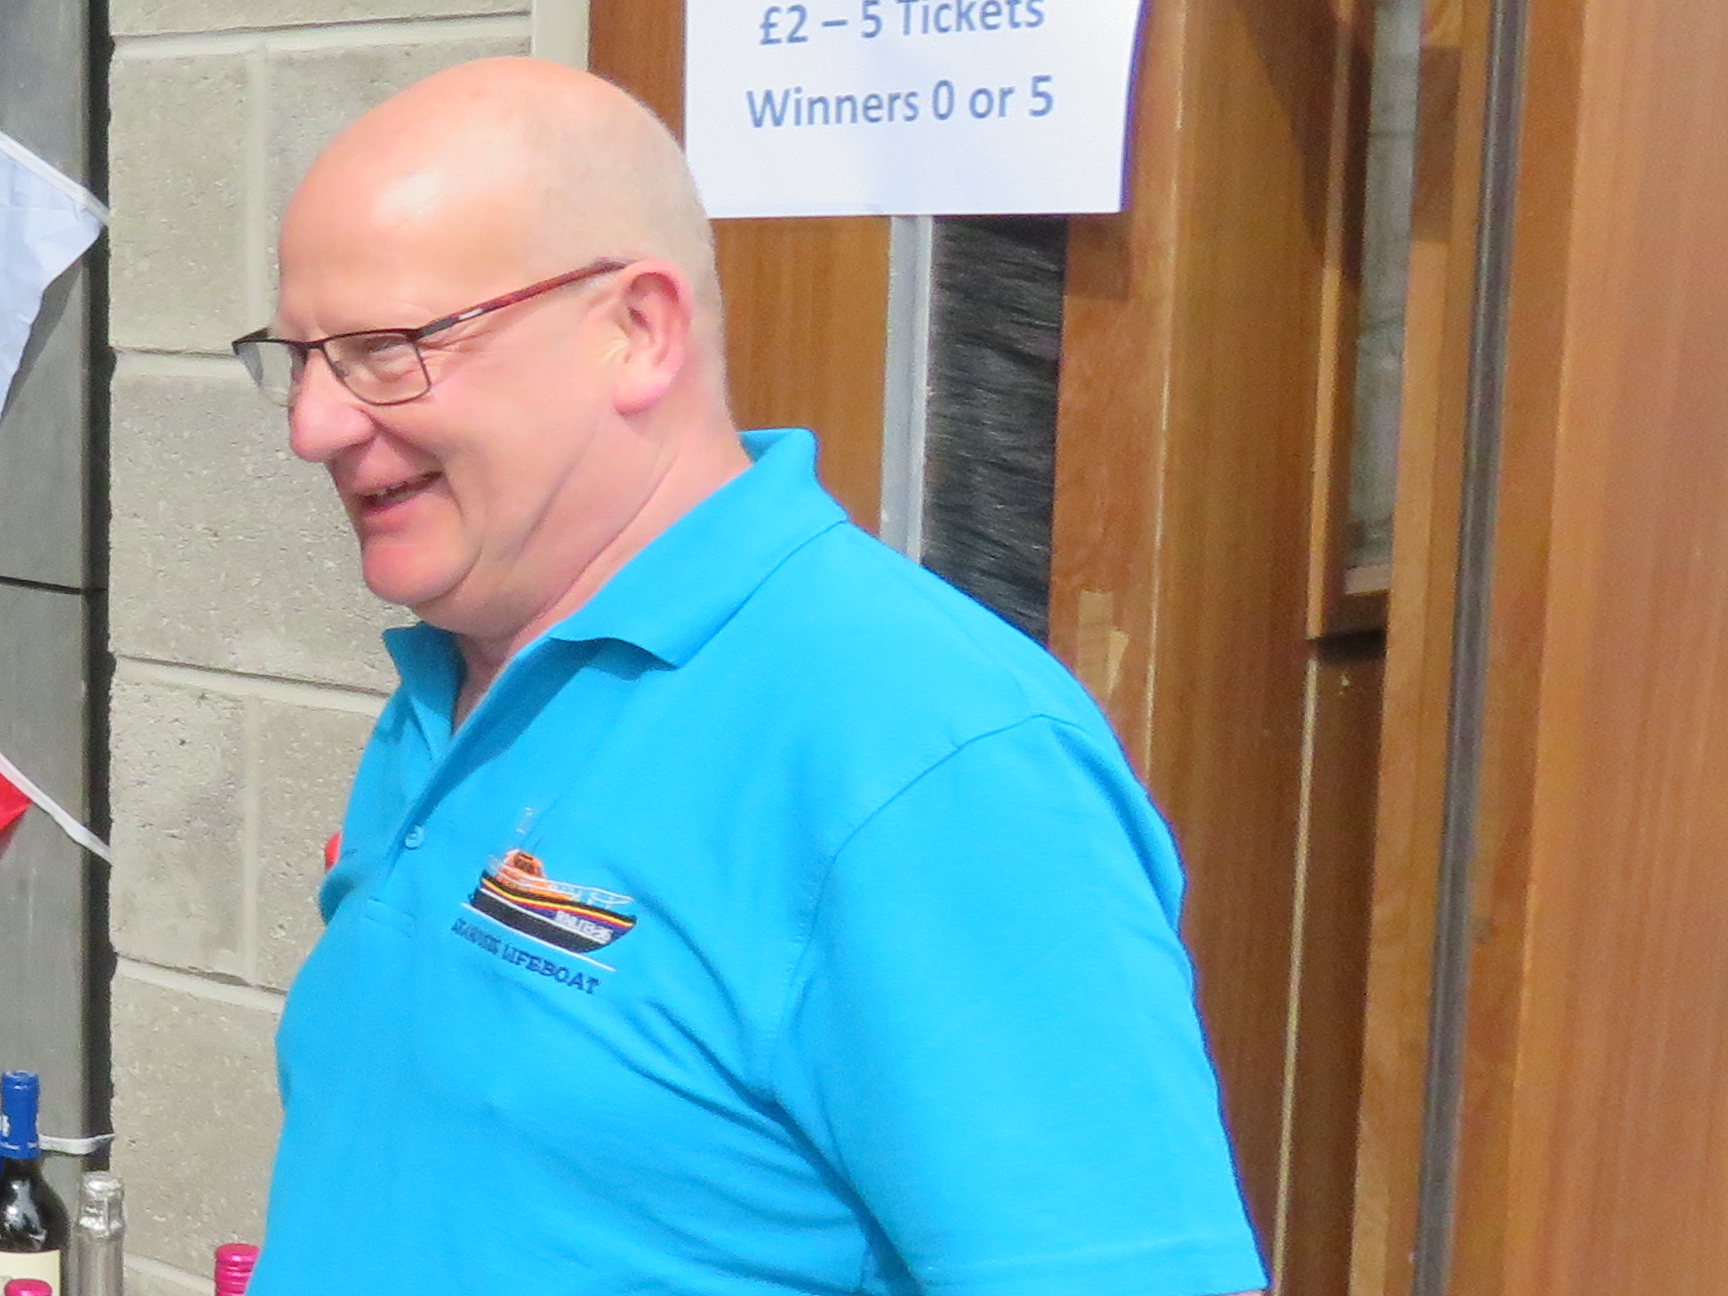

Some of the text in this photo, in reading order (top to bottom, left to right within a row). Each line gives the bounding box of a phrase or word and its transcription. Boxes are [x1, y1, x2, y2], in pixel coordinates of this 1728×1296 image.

[759, 4, 808, 46] £2
[746, 74, 1055, 128] Winners 0 or 5
[502, 943, 601, 994] LIFEBOAT
